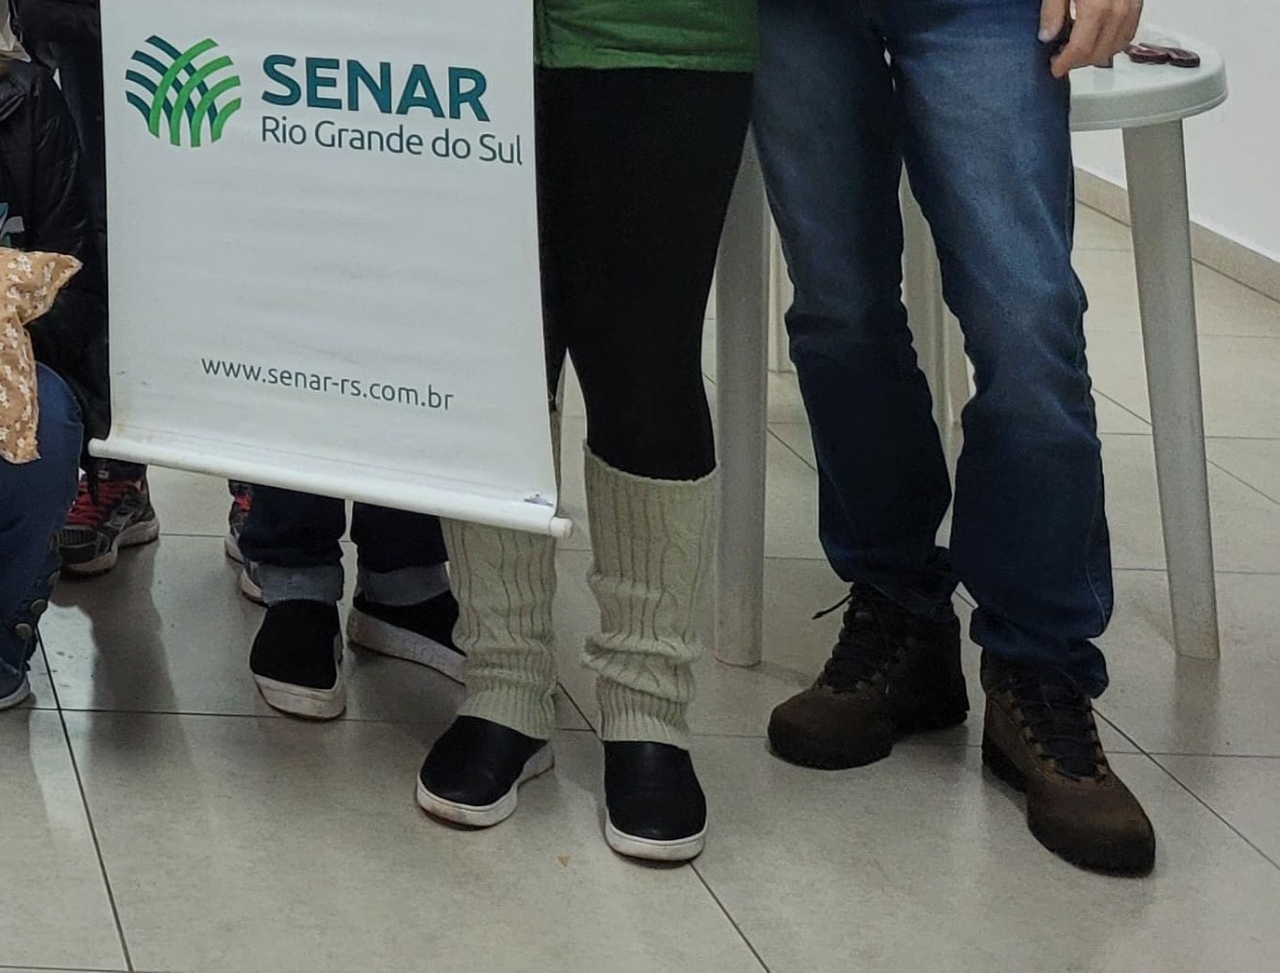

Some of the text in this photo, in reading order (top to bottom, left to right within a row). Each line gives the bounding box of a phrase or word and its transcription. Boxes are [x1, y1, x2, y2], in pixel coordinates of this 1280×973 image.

[260, 54, 491, 123] SENAR
[261, 115, 523, 166] Rio Grande do Sul
[201, 358, 454, 411] www.senar-rs.com.br
